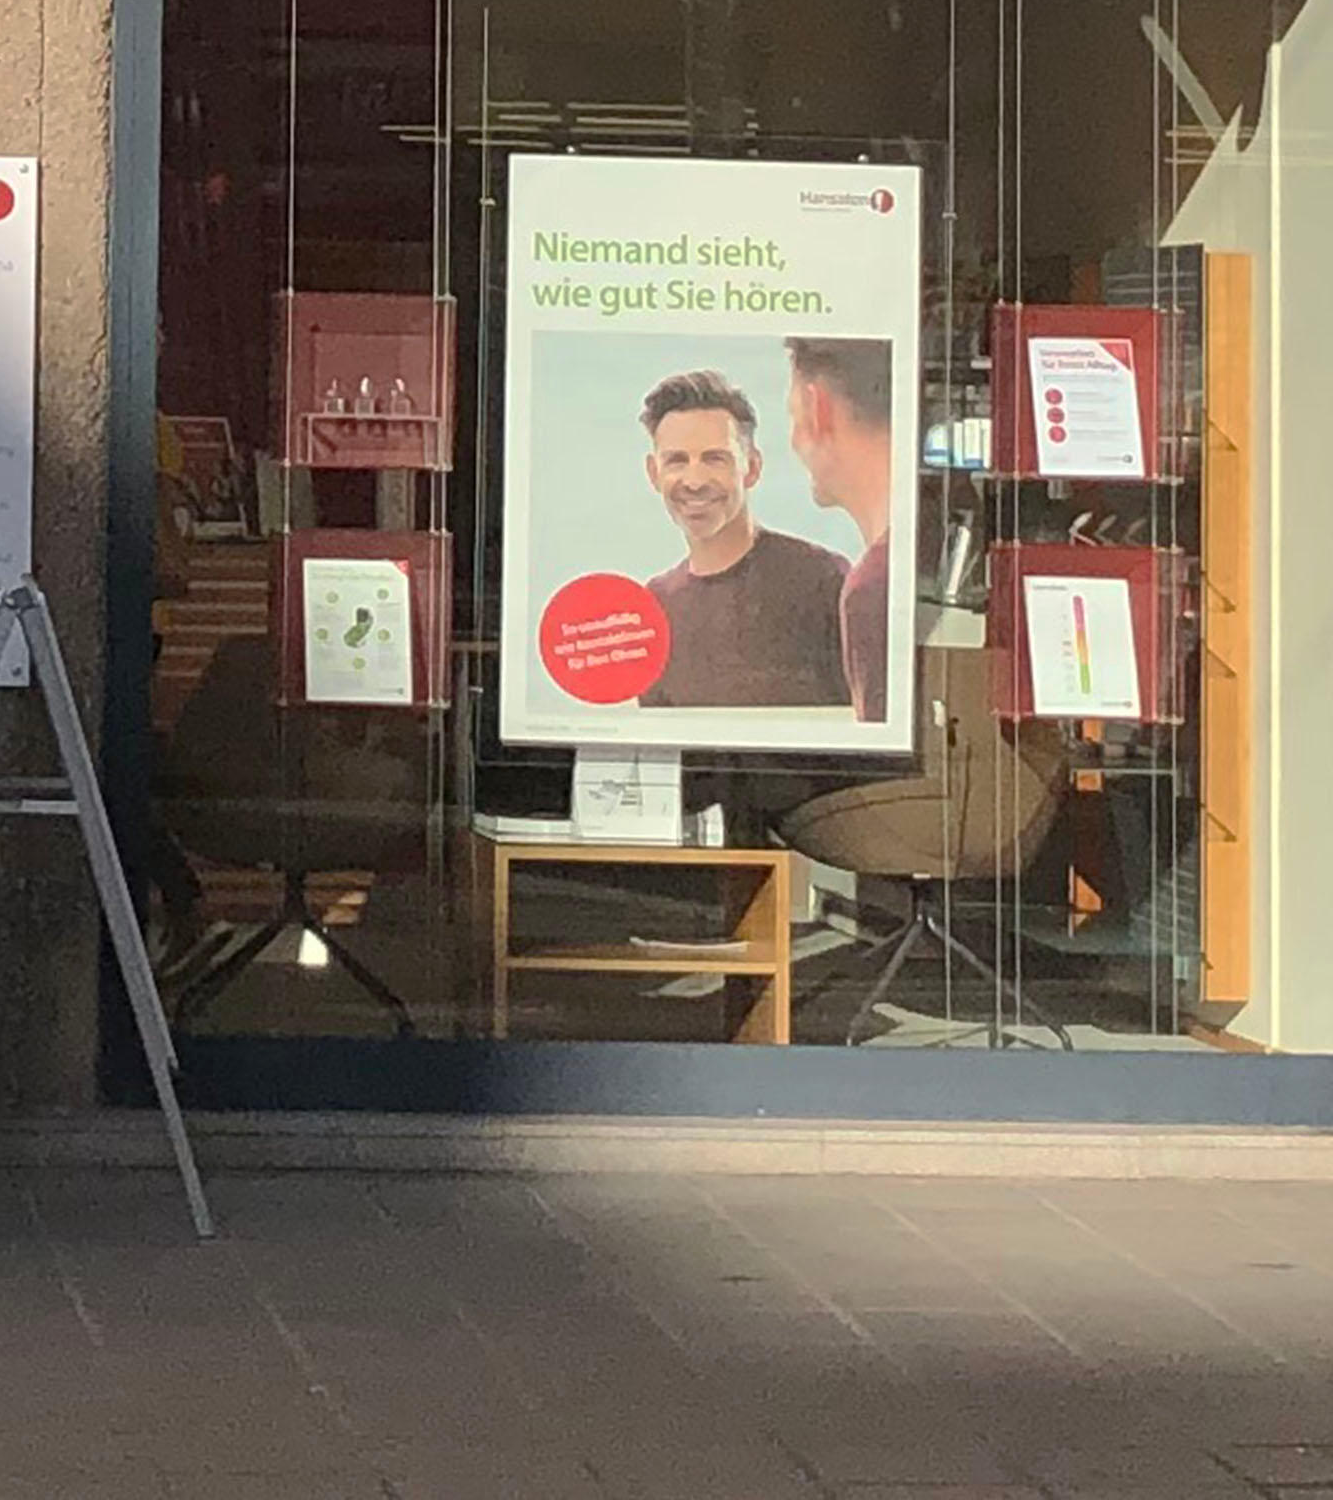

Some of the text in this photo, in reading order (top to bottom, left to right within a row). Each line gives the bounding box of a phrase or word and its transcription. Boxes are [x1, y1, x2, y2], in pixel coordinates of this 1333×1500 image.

[533, 231, 787, 271] Niemand sieht,
[532, 277, 834, 317] wie gut Sie hören.
